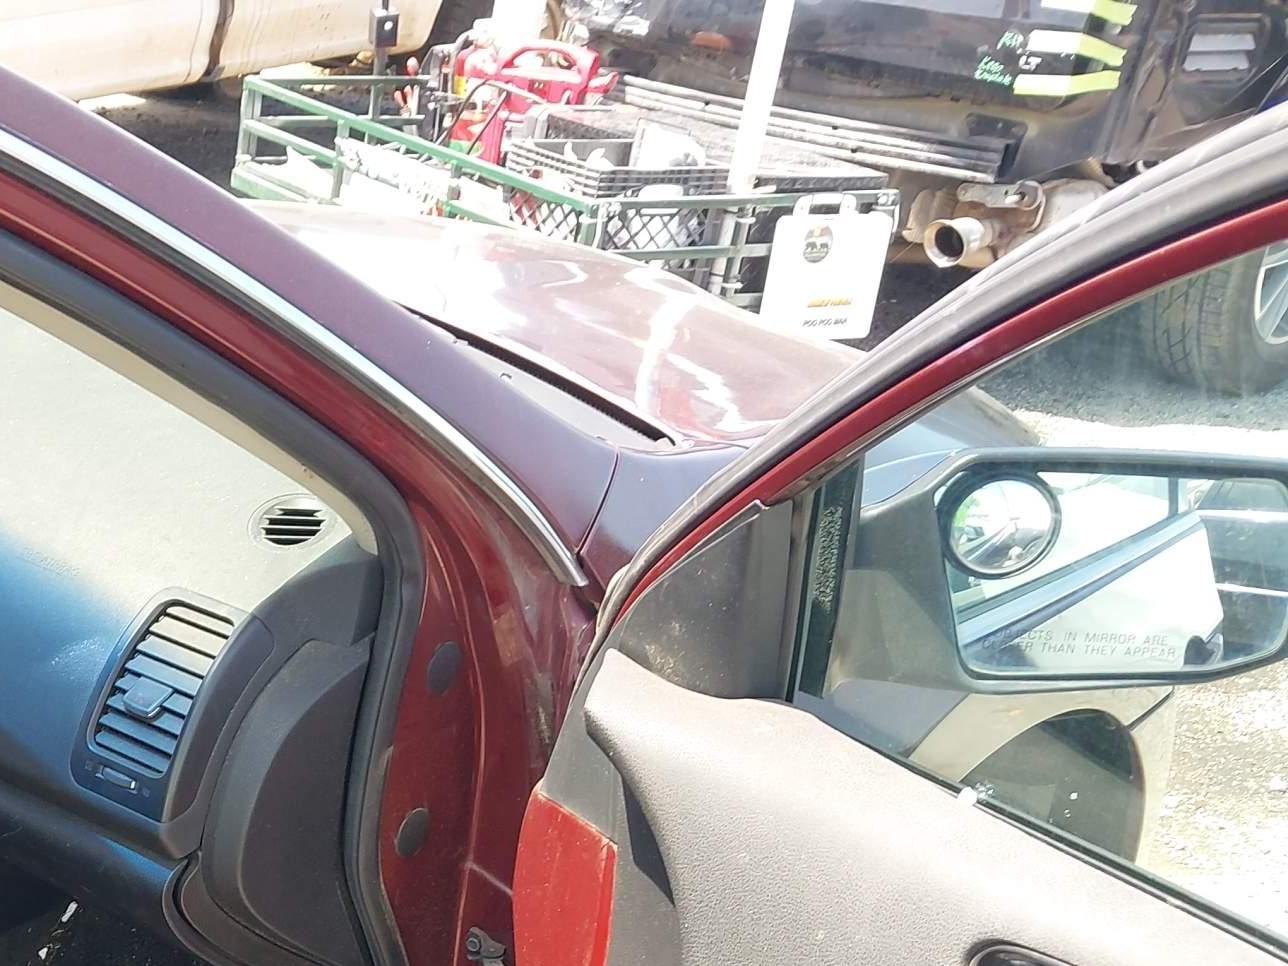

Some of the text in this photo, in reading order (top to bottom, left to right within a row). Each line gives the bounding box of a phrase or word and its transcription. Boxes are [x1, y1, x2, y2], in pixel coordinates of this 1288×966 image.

[1063, 631, 1078, 642] IN
[1084, 632, 1136, 645] MIRROR
[1143, 634, 1169, 647] ARE
[982, 639, 1177, 659] CLER THAN THEY APPEAR
